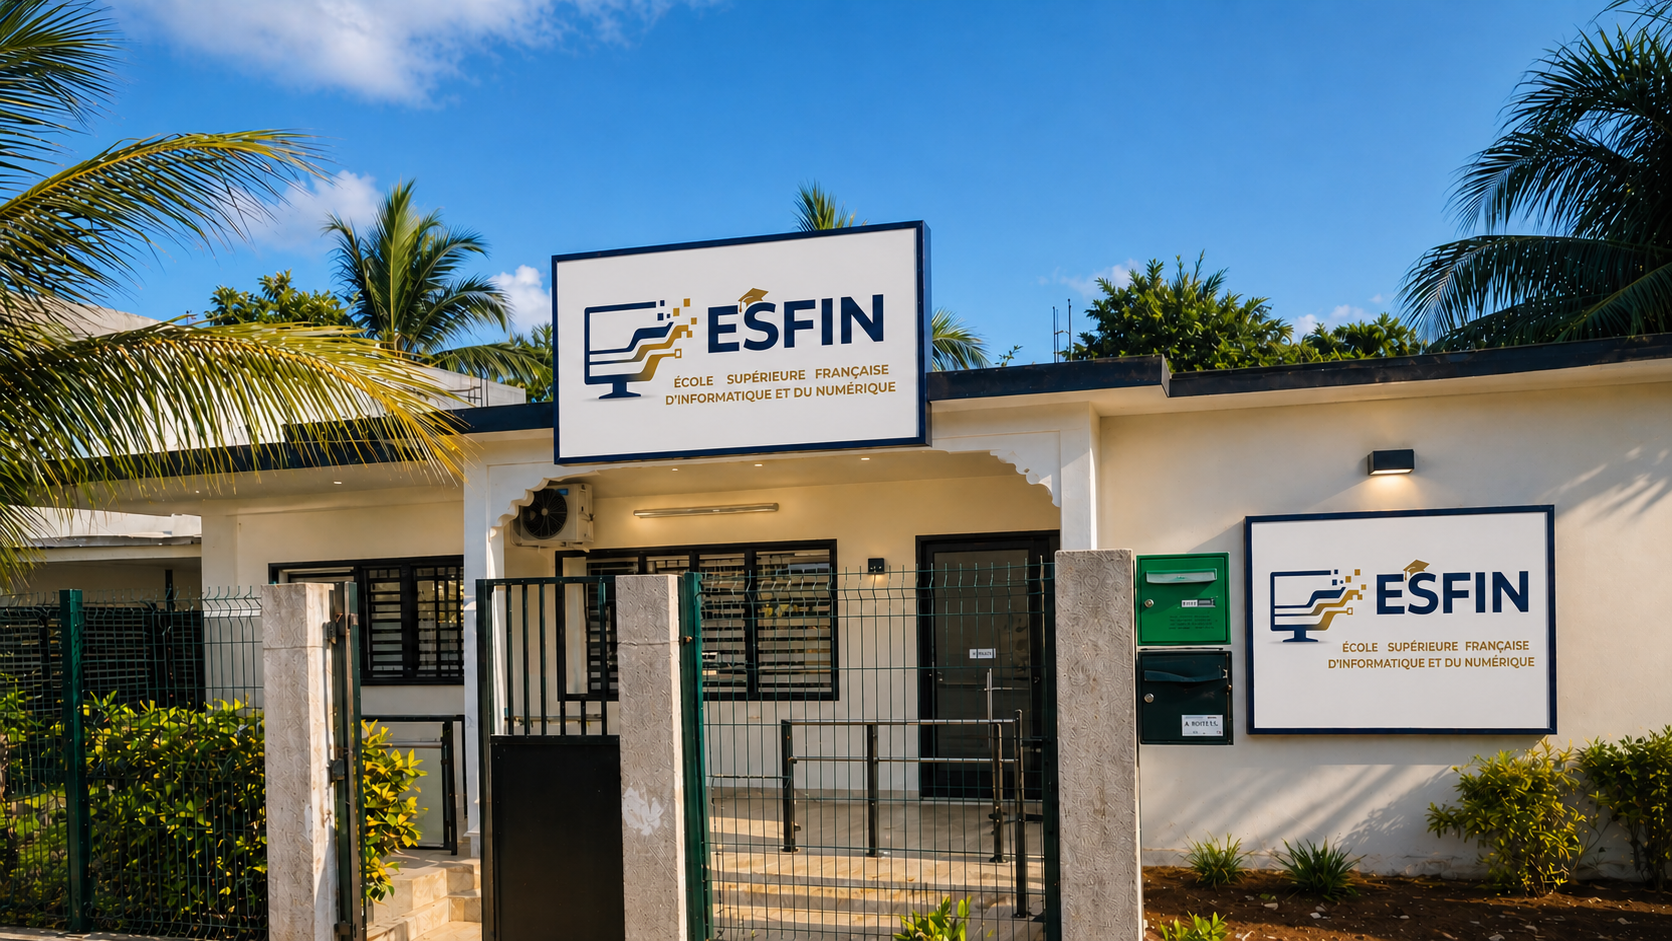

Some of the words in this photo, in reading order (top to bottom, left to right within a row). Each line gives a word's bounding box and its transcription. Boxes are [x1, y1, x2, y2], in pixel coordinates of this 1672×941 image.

[708, 293, 885, 354] ESFIN
[673, 374, 714, 388] ÉCOLE
[726, 368, 806, 385] SUPÉRIEURE
[815, 364, 890, 380] FRANÇAISE
[665, 388, 773, 406] D'INFORMATIQUE
[775, 388, 791, 399] ET
[793, 386, 814, 398] DU
[816, 381, 897, 397] NUMÉRIQUE
[1376, 570, 1530, 616] ESFIN
[1342, 640, 1379, 653] ÉCOLE
[1387, 639, 1459, 653] SUPÉRIEURE
[1465, 640, 1530, 654] FRANÇAISE
[1328, 657, 1426, 670] D'INFORMATIQUE
[1428, 657, 1442, 668] ET
[1444, 657, 1462, 668] DU
[1465, 655, 1535, 669] NUMÉRIQUE
